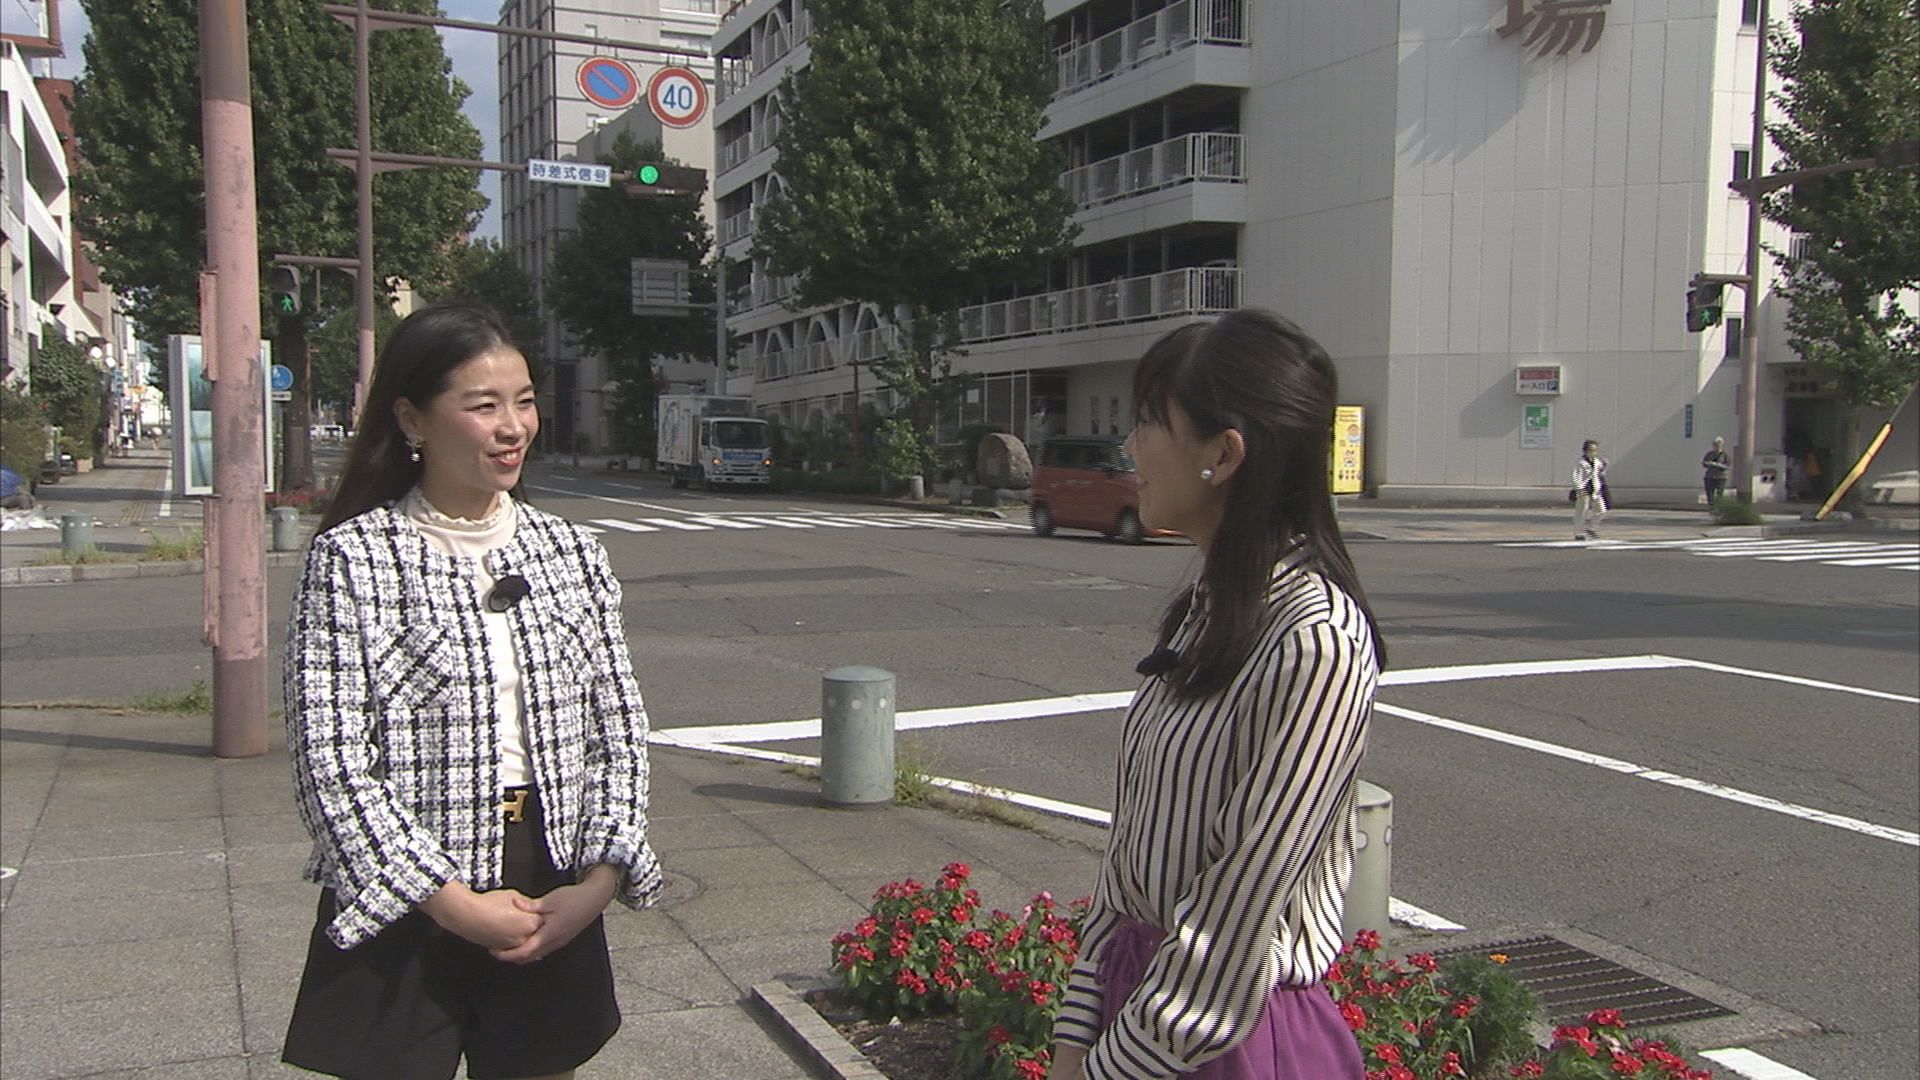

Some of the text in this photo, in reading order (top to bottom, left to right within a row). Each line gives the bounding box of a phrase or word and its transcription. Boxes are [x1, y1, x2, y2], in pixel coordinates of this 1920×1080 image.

[662, 84, 692, 110] 40
[532, 163, 607, 183] 時差式信号
